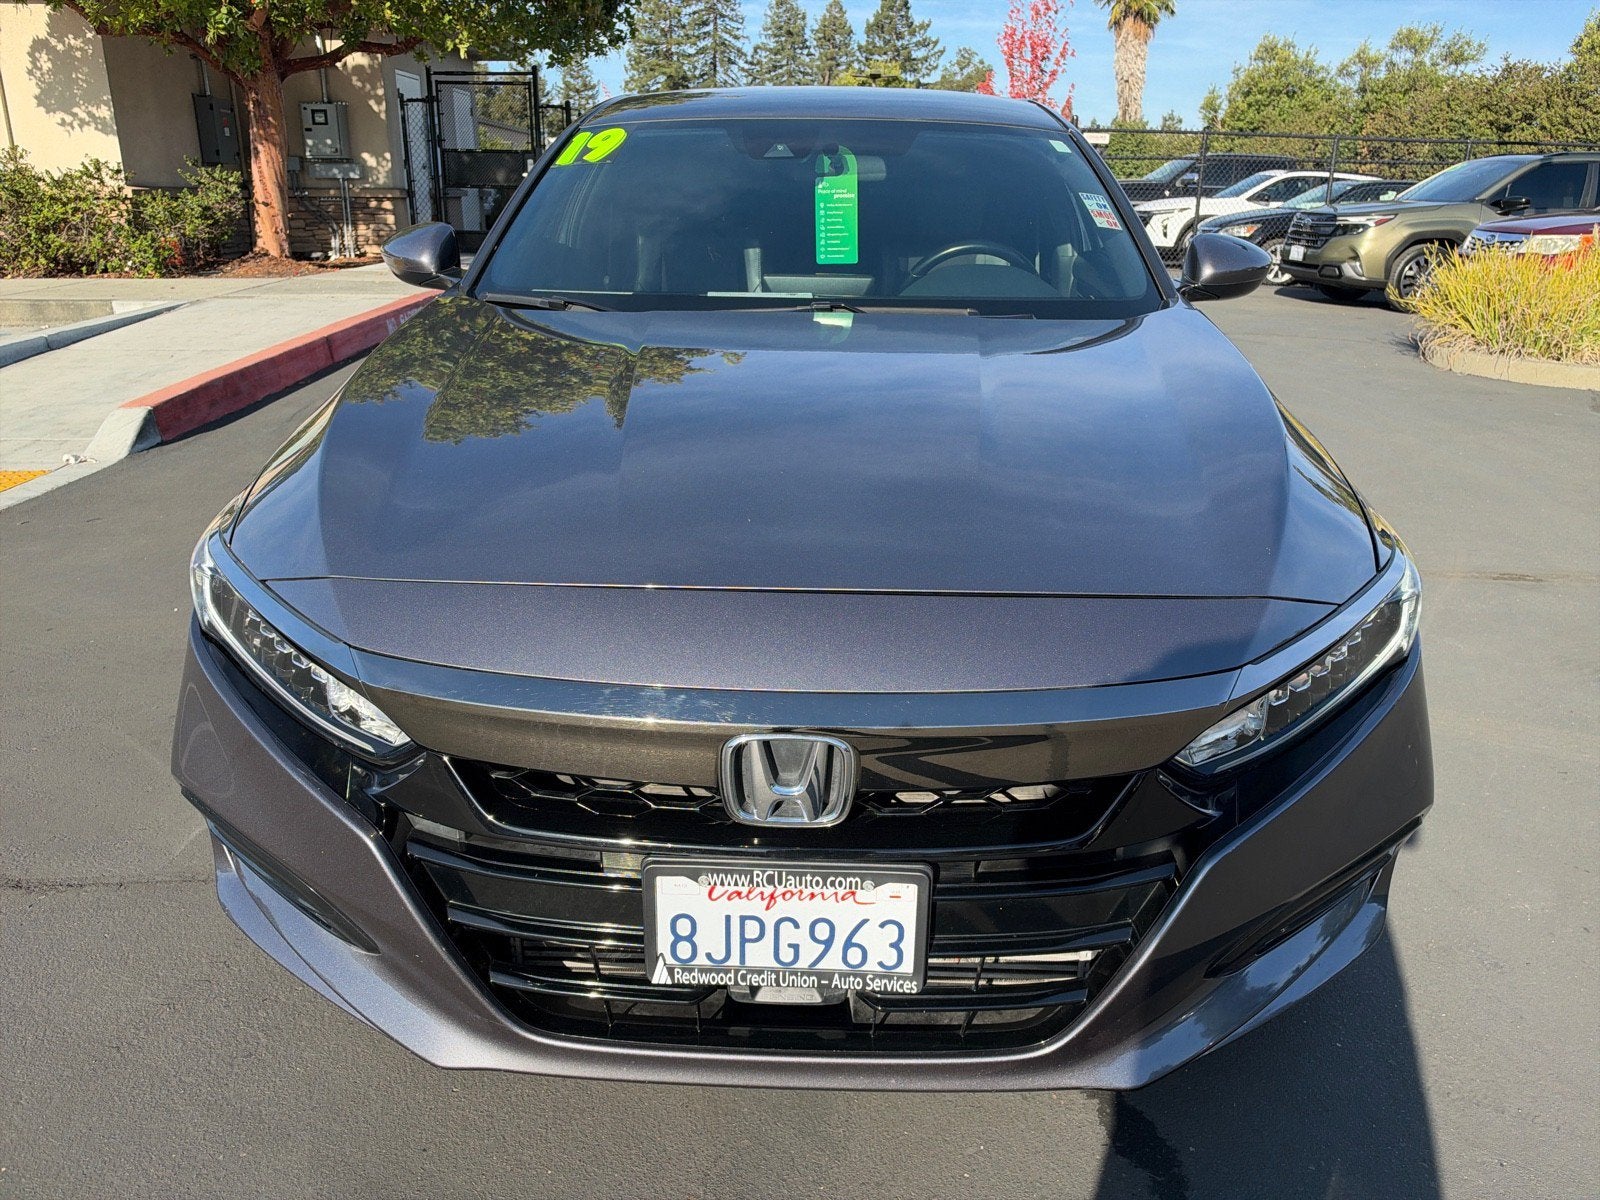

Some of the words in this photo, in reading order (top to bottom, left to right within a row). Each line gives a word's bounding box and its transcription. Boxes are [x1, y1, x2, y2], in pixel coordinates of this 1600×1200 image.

[555, 127, 628, 166] 19
[1090, 210, 1115, 220] SMOG
[1096, 202, 1110, 210] OK
[1106, 219, 1120, 228] OK
[708, 870, 861, 891] www.RCUauto.com
[707, 885, 876, 911] California
[669, 912, 905, 971] 8JPG963
[674, 968, 734, 986] Redwood
[738, 969, 776, 987] Credit
[780, 971, 818, 988] Union
[832, 973, 863, 990] Auto
[866, 974, 918, 993] Services
